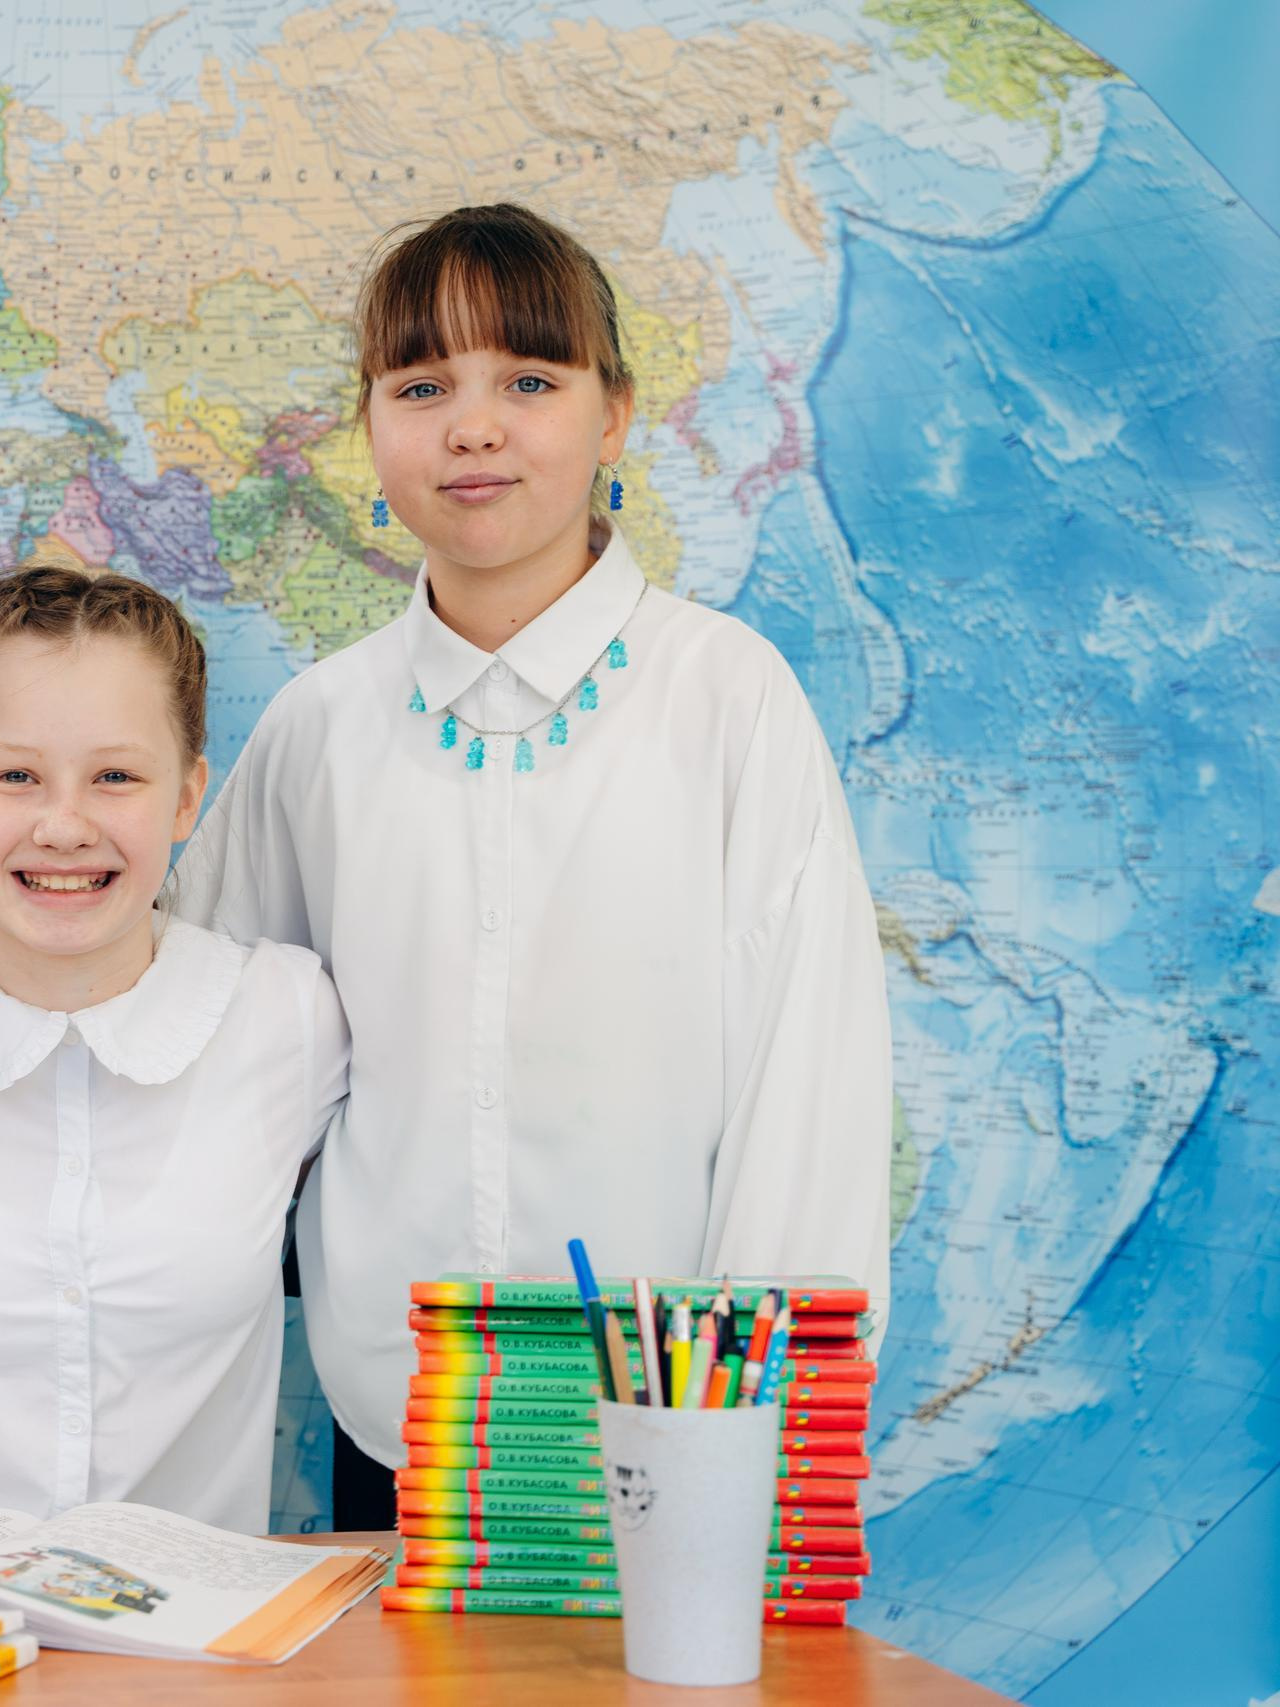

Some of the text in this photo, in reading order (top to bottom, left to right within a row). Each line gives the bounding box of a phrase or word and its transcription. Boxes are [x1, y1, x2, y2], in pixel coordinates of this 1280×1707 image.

[73, 164, 417, 184] РОССИЙСКАЯ
[502, 1338, 581, 1350] О.В.КУБАСОВА
[508, 1361, 588, 1372] О.В.КУБАСОВА
[498, 1383, 580, 1395] О.В.КУБАСОВА
[496, 1407, 577, 1418] О.В.КУБАСОВА
[493, 1431, 573, 1443] О.В.КУБАСОВА
[497, 1454, 579, 1465] О.В.КУБАСОВА
[486, 1478, 568, 1490] О.В.КУБАСОВА
[488, 1501, 570, 1514] О.В.КУБАСОВА
[488, 1525, 570, 1537] О.В.КУБАСОВА
